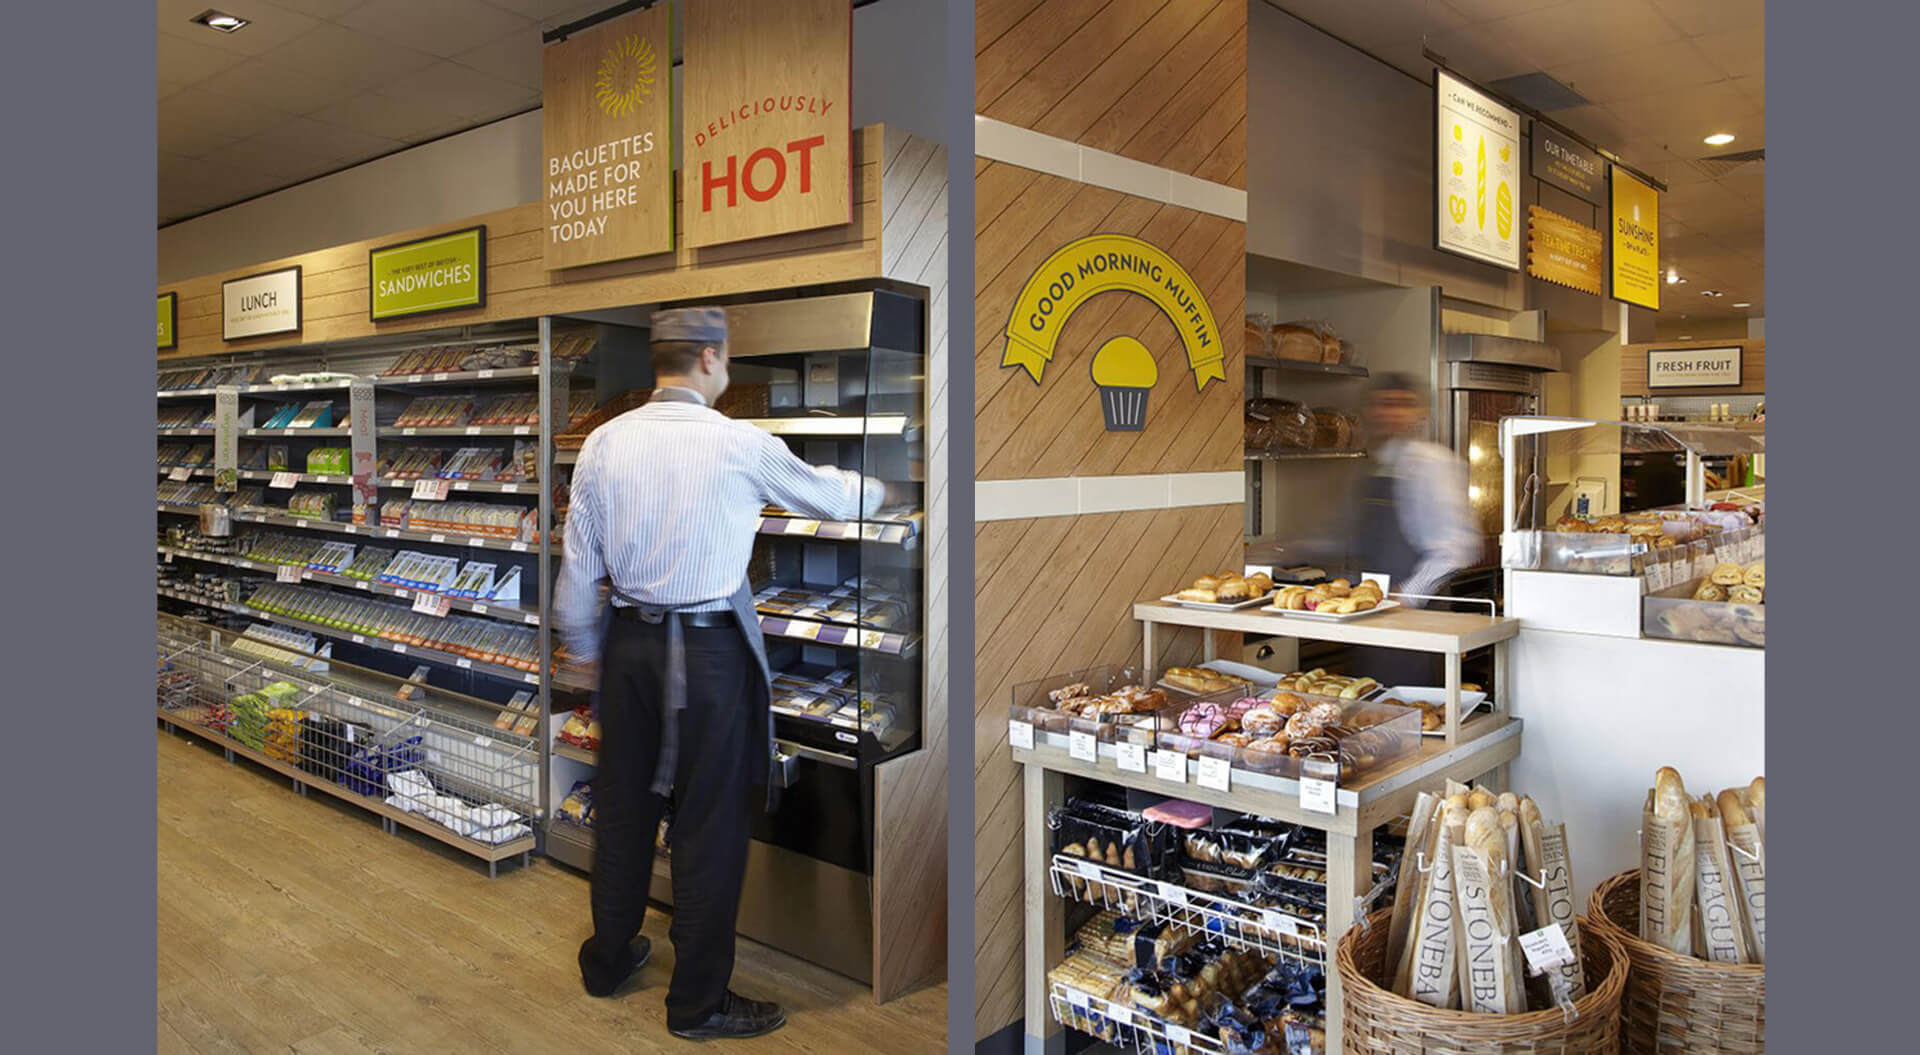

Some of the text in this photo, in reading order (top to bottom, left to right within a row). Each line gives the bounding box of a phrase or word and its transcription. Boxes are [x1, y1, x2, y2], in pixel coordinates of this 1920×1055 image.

[695, 96, 832, 147] DELICIOUSLY
[550, 131, 654, 177] BAGUETTES
[550, 160, 640, 199] MADE FOR
[702, 134, 825, 213] HOT
[550, 185, 637, 221] YOU HERE
[550, 215, 607, 243] TODAY
[1618, 217, 1655, 247] SUNSHINE
[379, 263, 472, 297] SANDWICHES
[241, 291, 277, 312] LUNCH
[1029, 252, 1211, 349] GOOD MORNING MUFFIN
[1656, 360, 1732, 372] FRESH FRUIT
[1647, 852, 1666, 934] FLUTE
